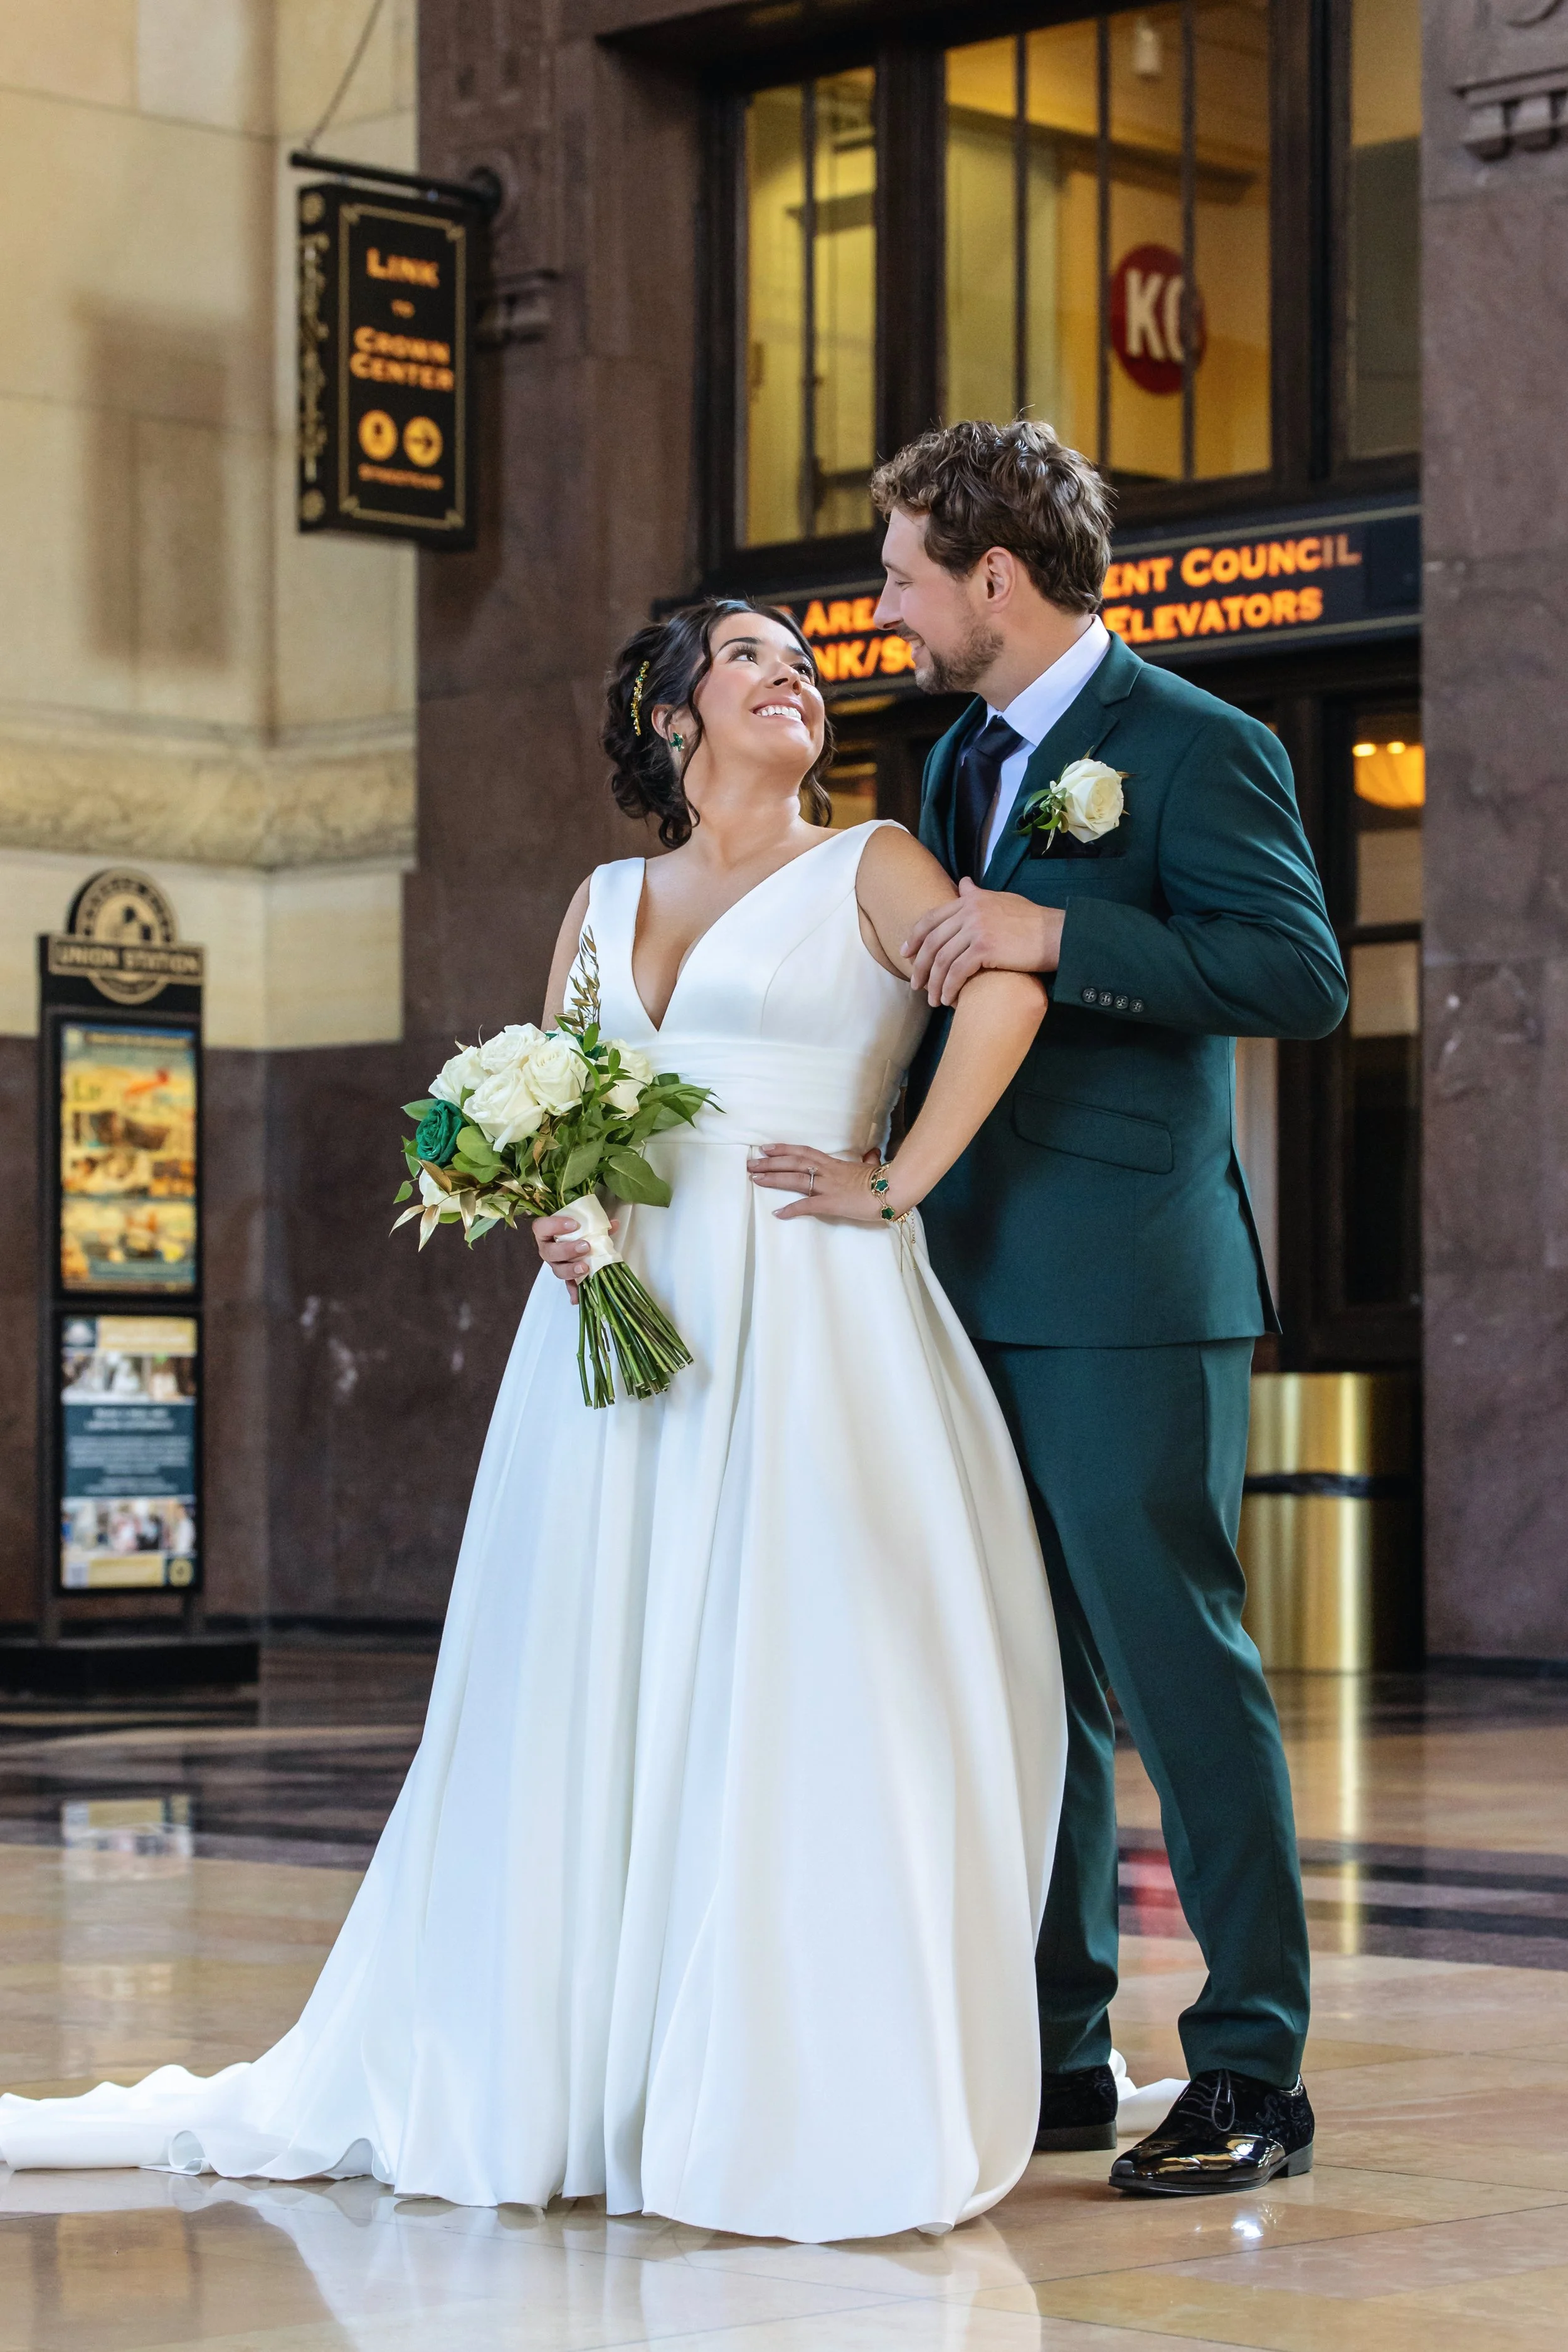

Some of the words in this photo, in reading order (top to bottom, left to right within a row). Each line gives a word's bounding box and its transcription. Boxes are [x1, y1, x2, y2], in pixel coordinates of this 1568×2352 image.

[350, 352, 455, 392] CENTER
[802, 597, 879, 638] ARE
[1180, 534, 1362, 587] COUNCIL
[1102, 586, 1323, 644] ELEVATORS
